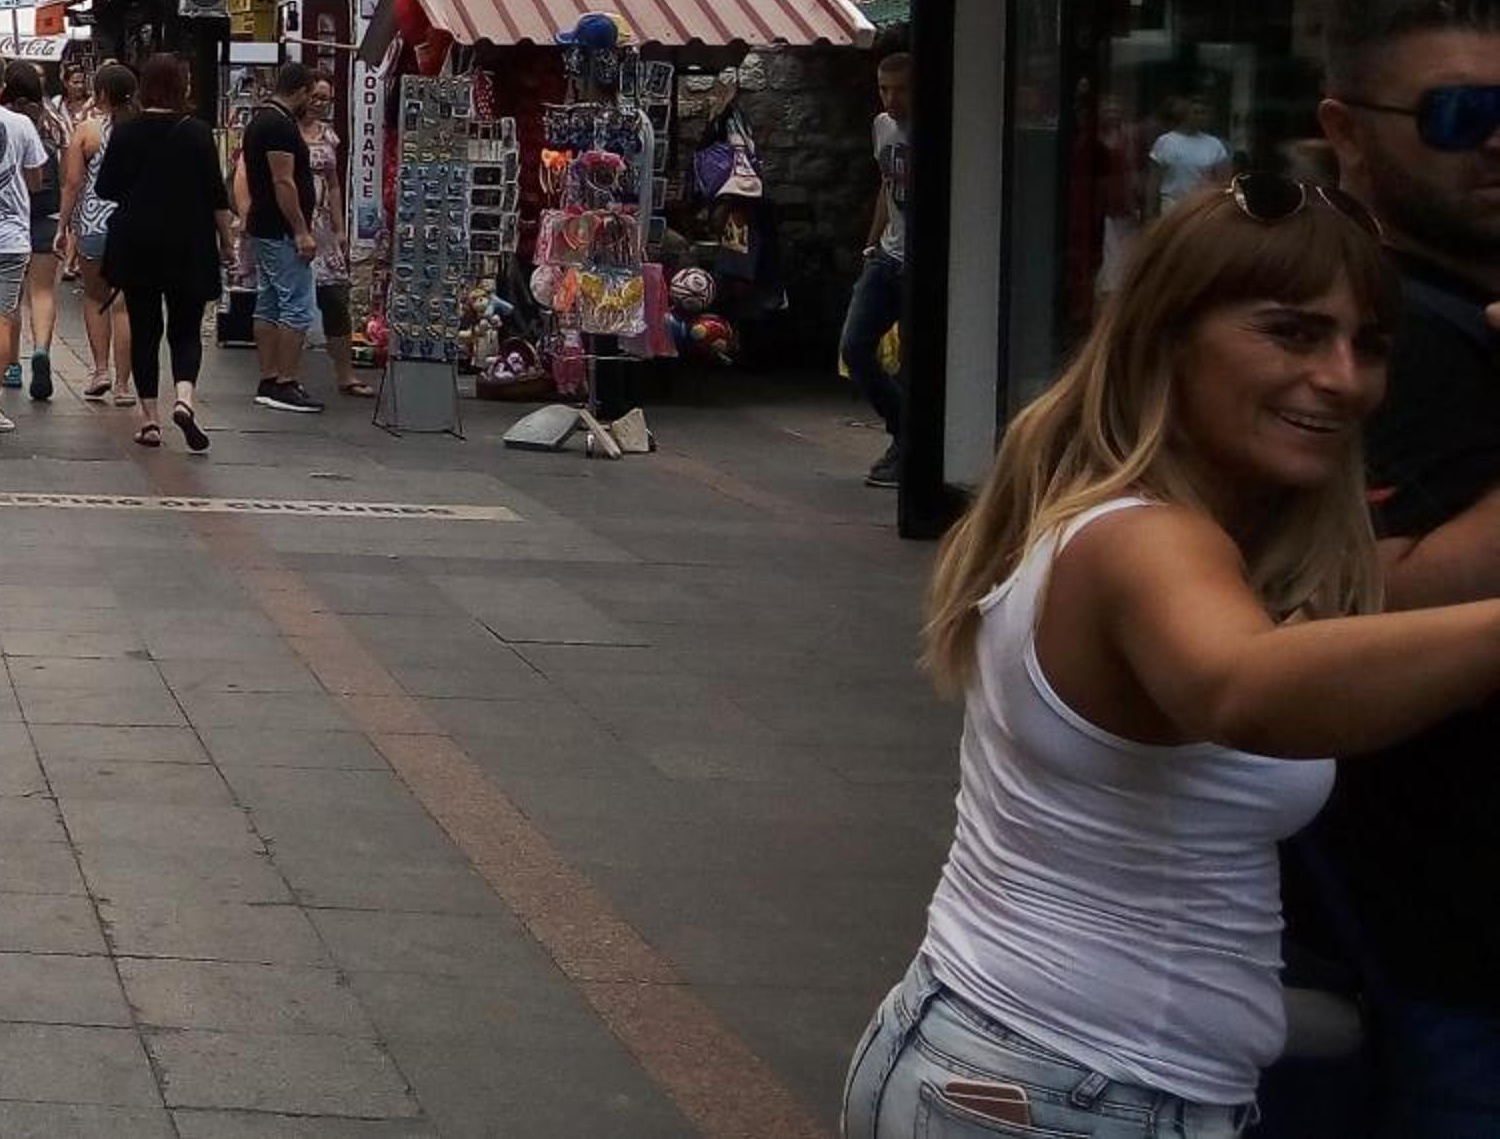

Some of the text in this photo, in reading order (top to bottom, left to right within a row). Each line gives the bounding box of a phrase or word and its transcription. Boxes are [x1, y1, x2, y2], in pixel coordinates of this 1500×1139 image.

[0, 36, 55, 56] Coa-Cola
[157, 498, 212, 510] OF
[223, 501, 456, 516] CULTURES
